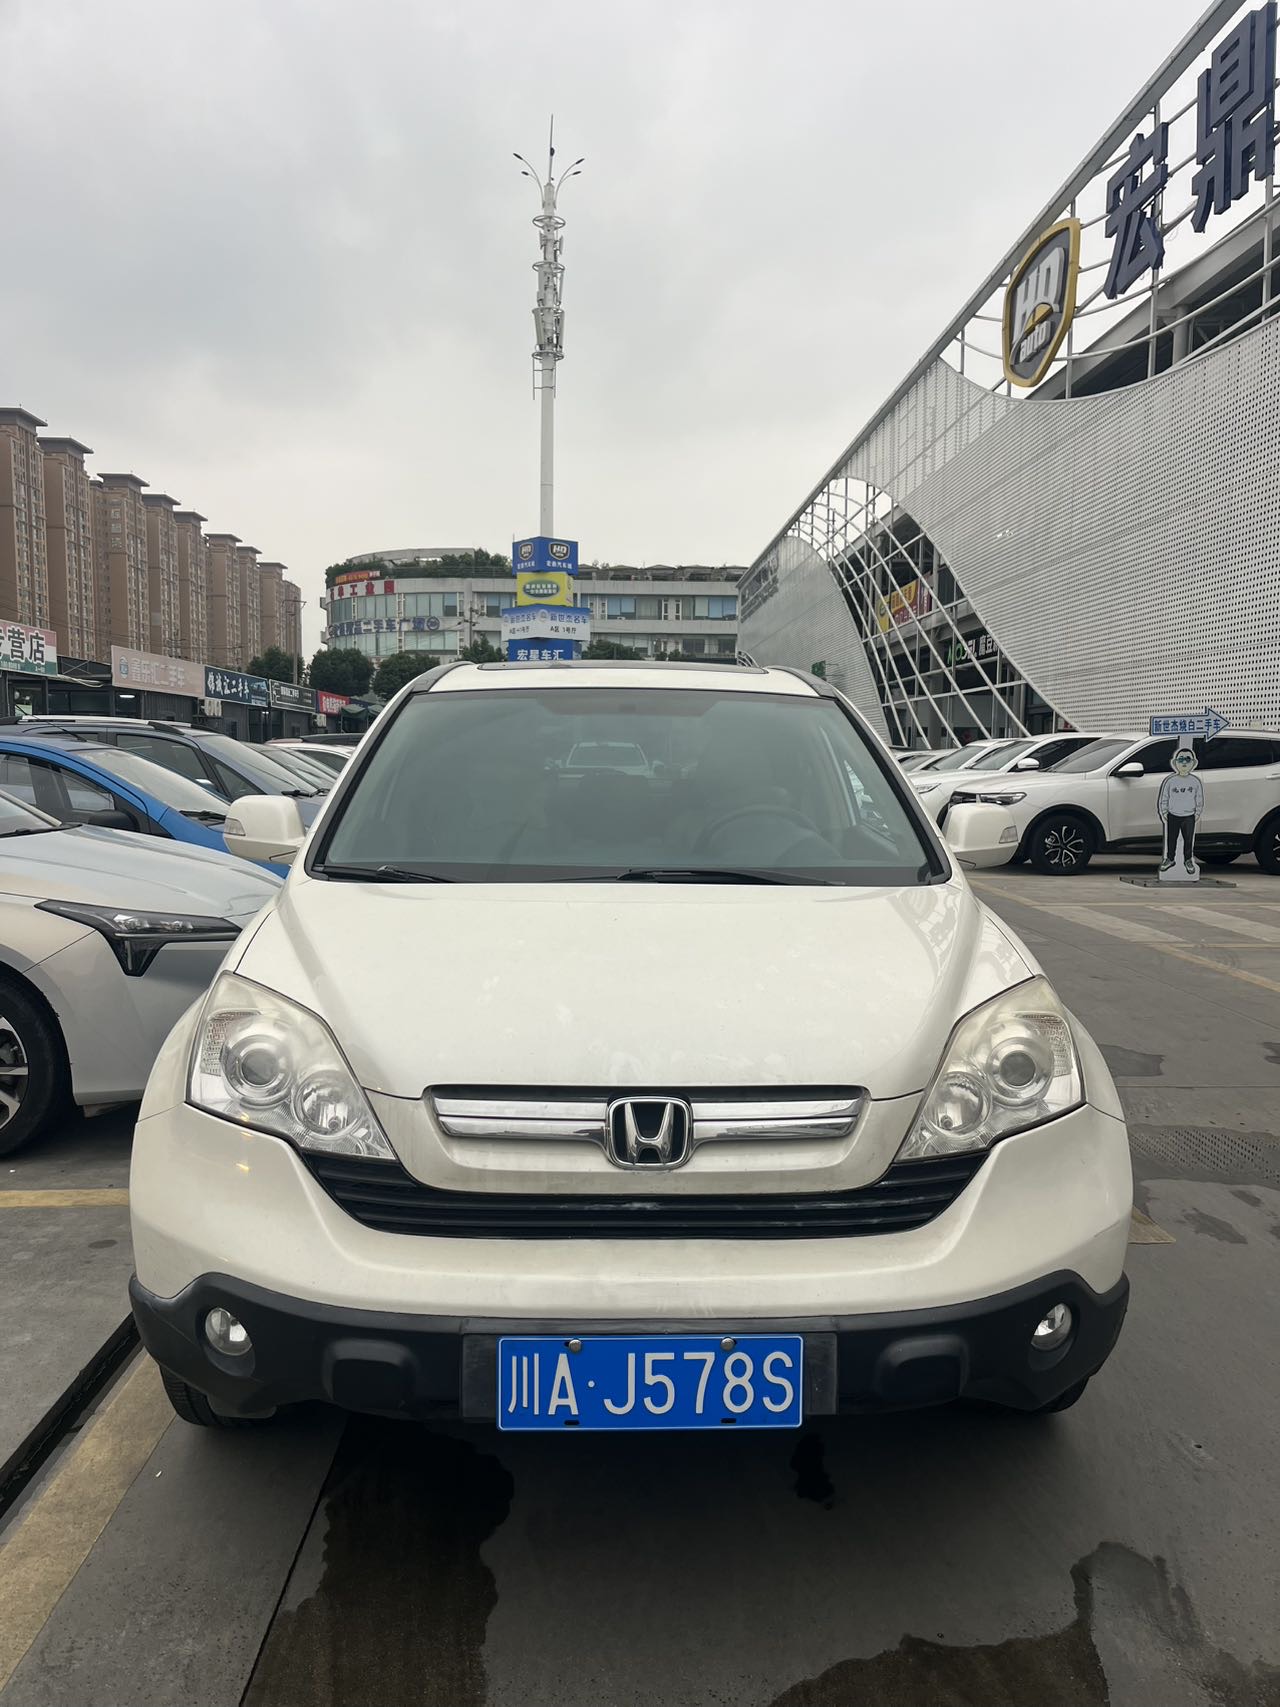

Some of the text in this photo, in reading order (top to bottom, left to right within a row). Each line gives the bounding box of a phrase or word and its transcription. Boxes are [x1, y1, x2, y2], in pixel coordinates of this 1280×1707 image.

[1103, 2, 1278, 300] 宏鼎
[1019, 320, 1055, 363] auto
[550, 613, 587, 624] 新世杰名车
[0, 626, 45, 665] 营店
[516, 649, 564, 661] 宏星车汇
[507, 1351, 795, 1415] 川A·J578S
